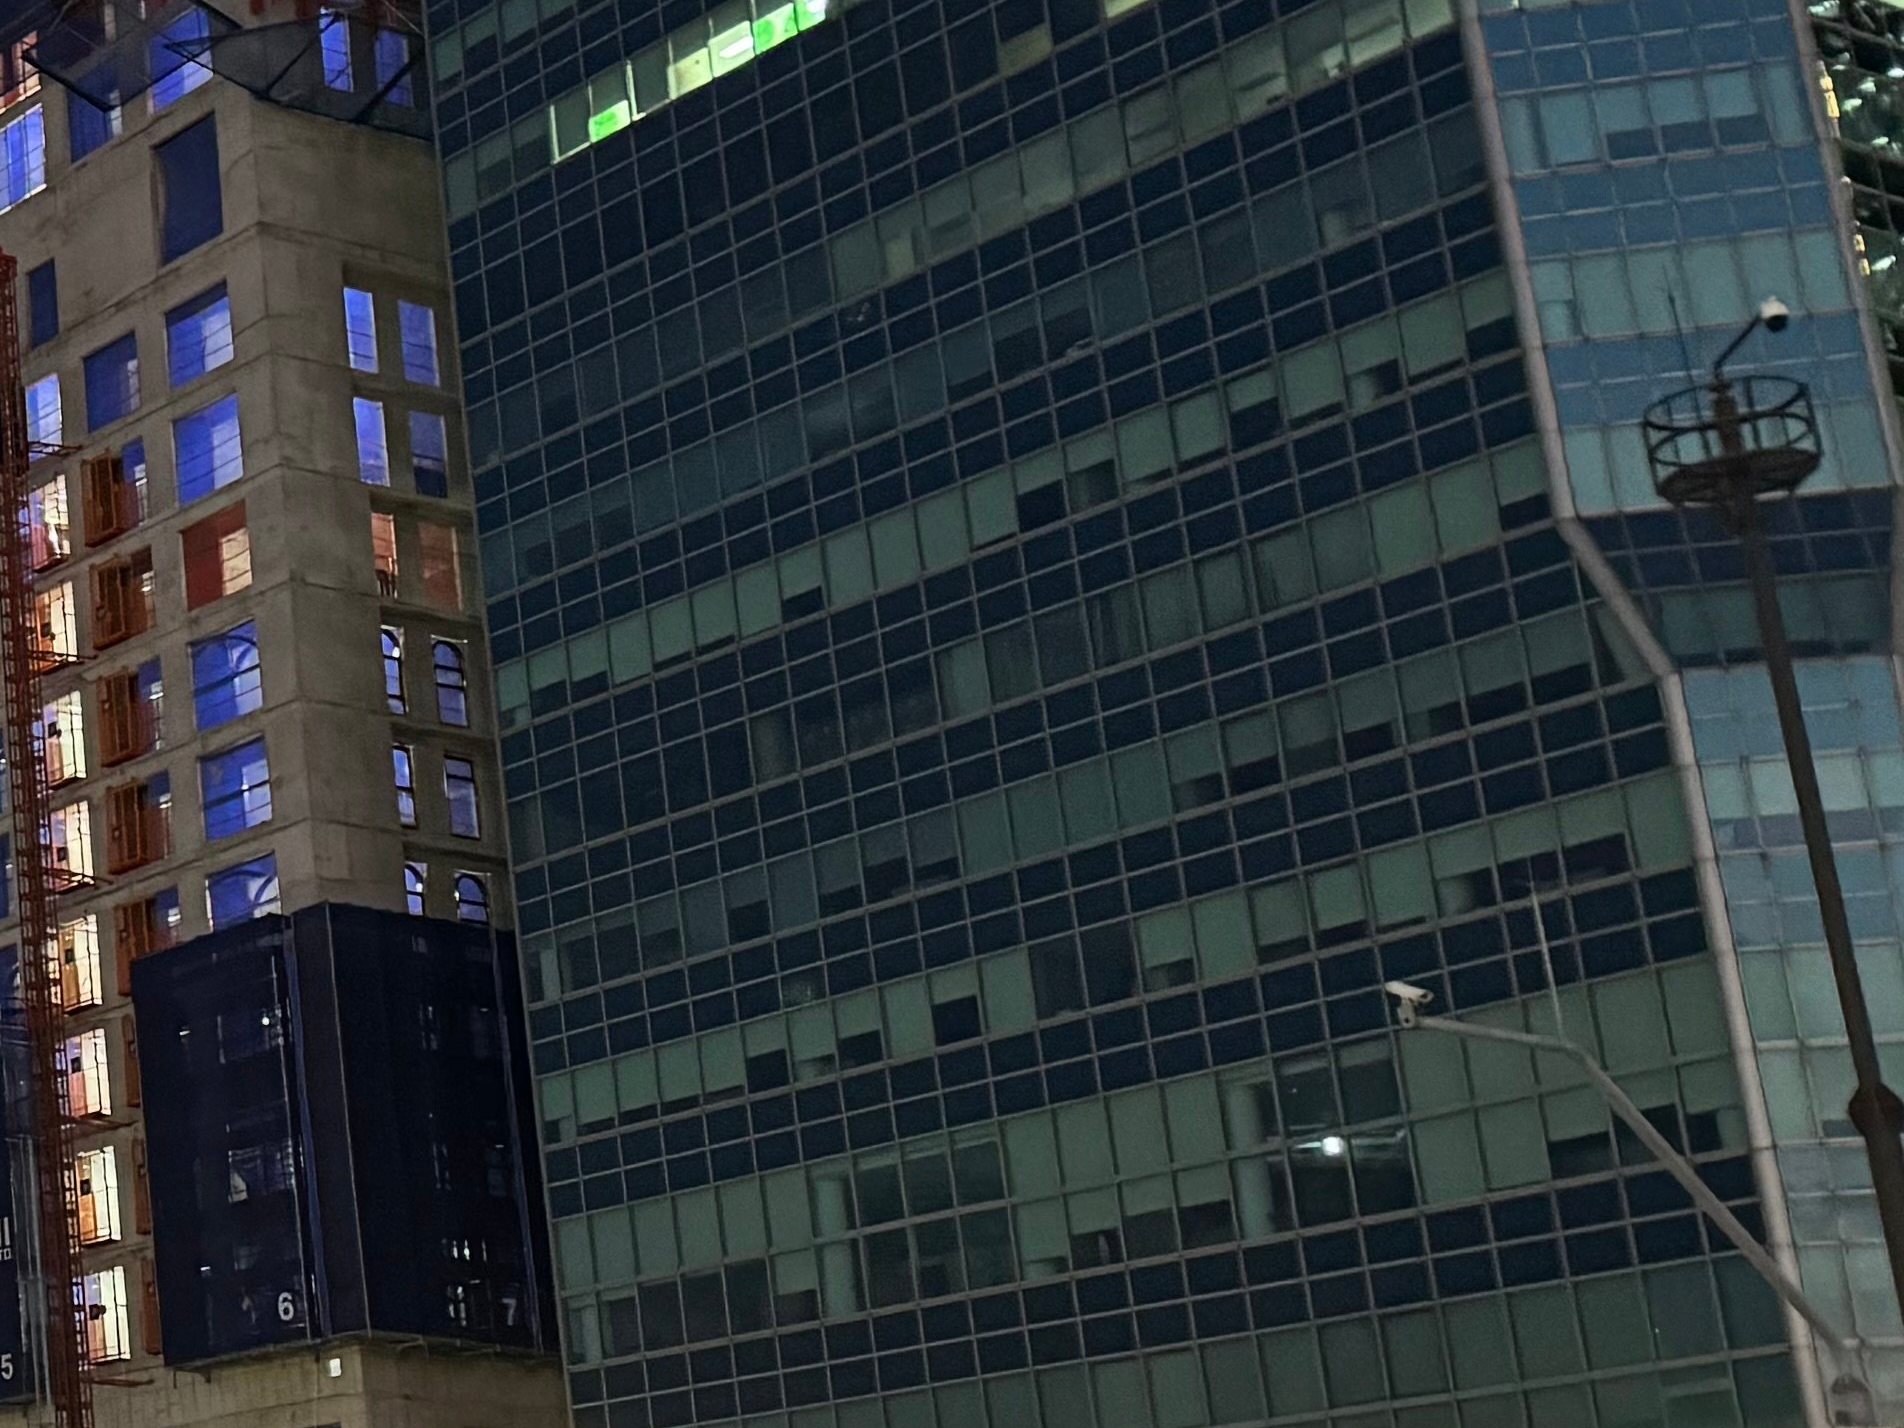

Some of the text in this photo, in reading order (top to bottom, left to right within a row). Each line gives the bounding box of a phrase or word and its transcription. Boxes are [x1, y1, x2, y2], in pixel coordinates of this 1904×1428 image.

[278, 1291, 294, 1321] 6
[501, 1297, 517, 1326] 7
[0, 1353, 14, 1381] 5
